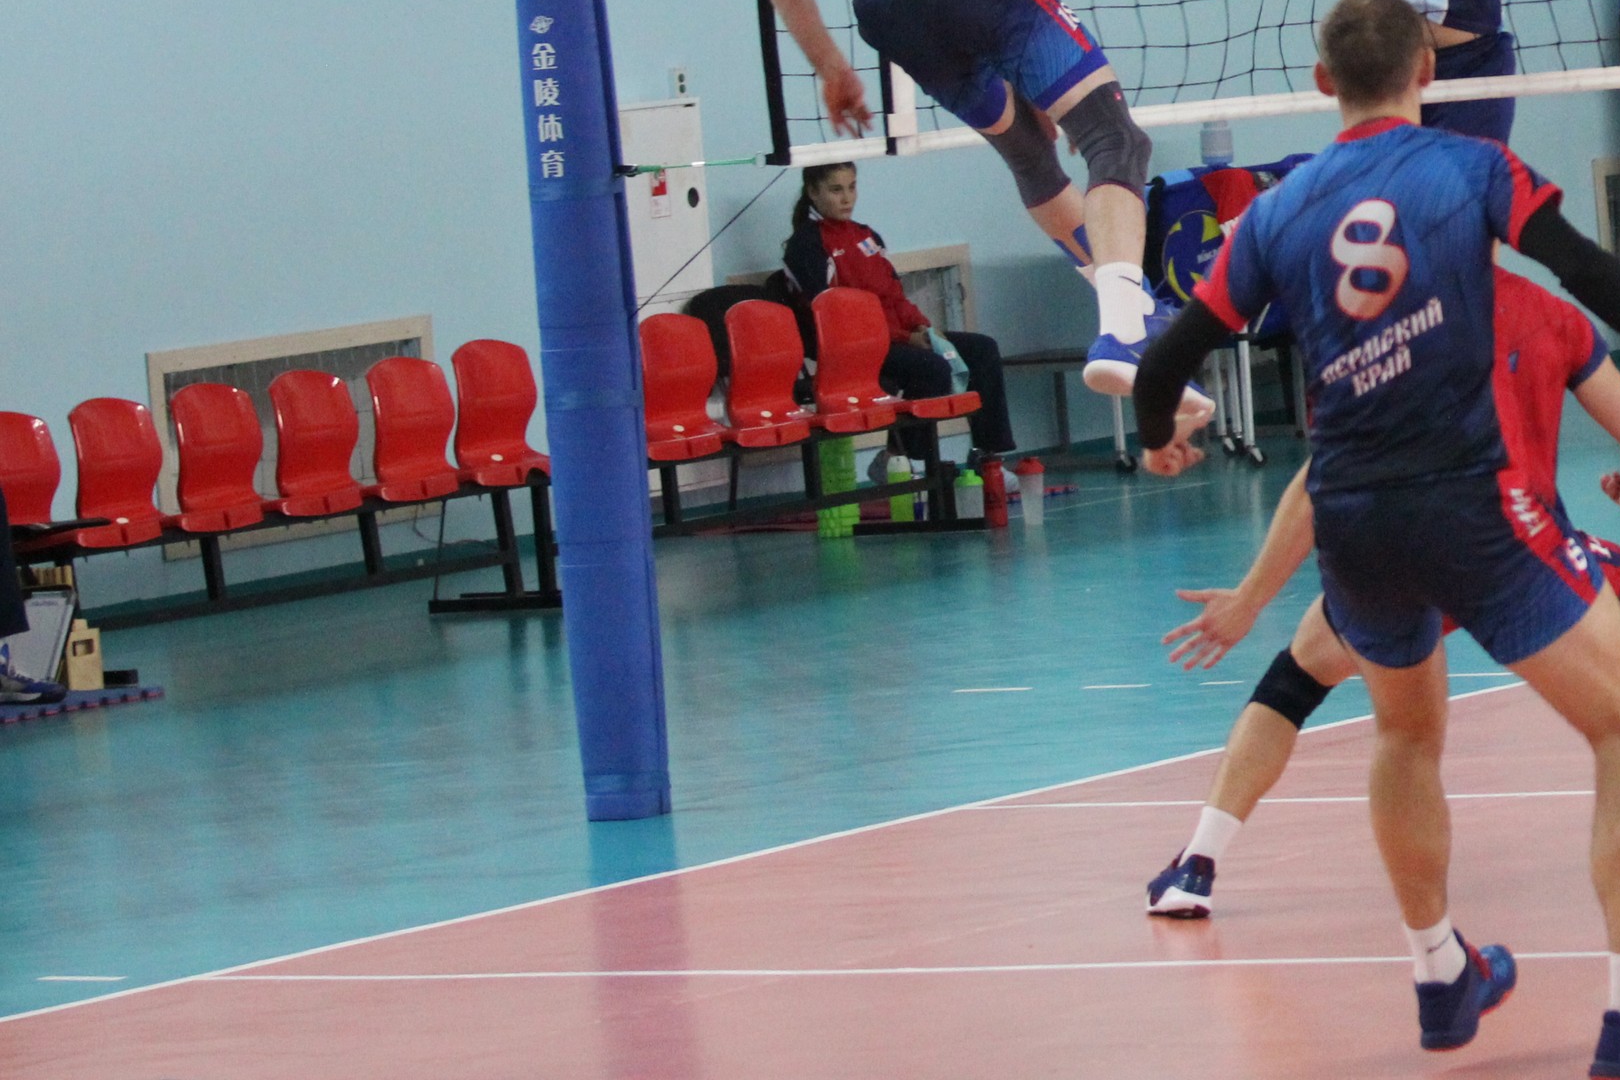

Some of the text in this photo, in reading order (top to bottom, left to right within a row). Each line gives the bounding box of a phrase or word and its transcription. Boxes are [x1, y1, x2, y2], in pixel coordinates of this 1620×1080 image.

[531, 42, 565, 178] 金陵体育
[1329, 197, 1410, 321] 8
[1320, 296, 1443, 385] ПЕРМСКИЙ
[1351, 344, 1411, 397] КРАЙ
